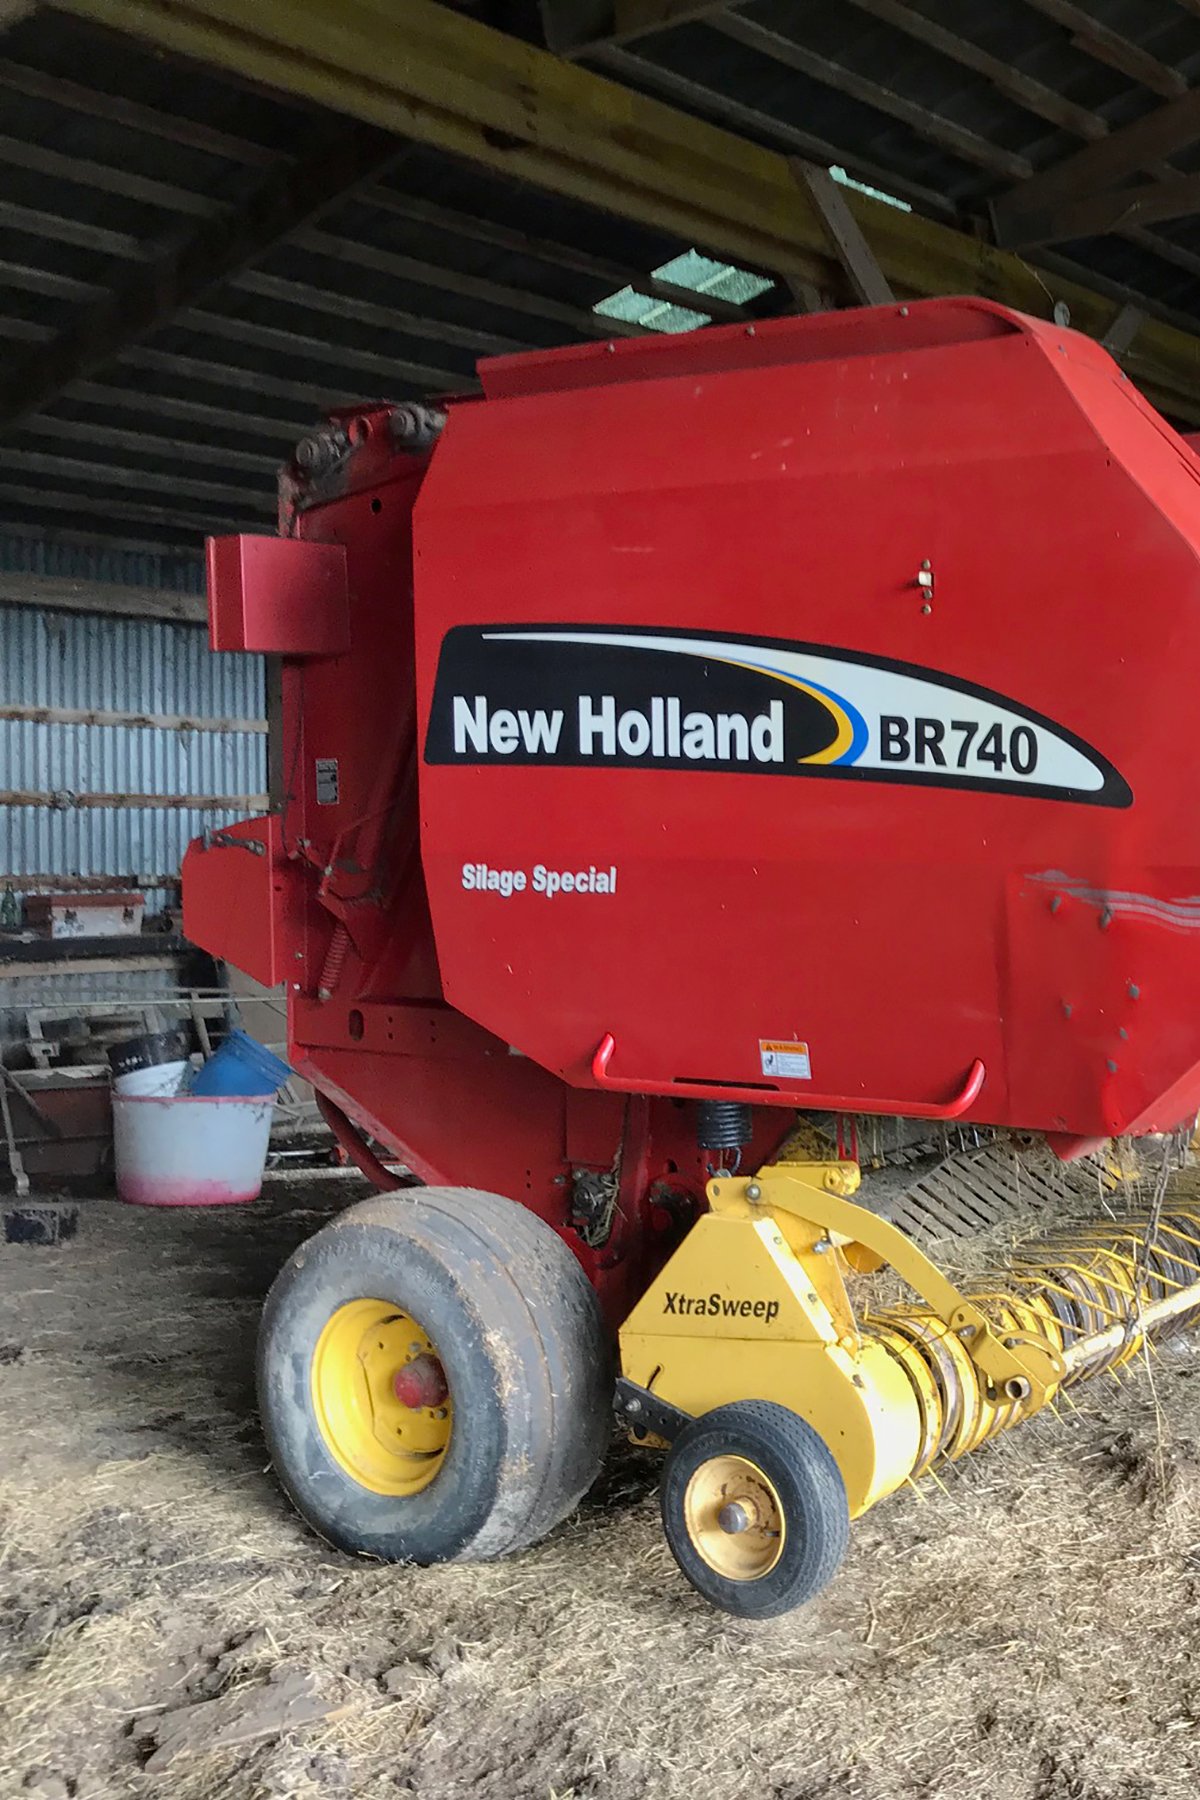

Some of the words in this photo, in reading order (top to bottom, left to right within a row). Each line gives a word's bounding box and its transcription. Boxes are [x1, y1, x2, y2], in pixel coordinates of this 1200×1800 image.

[453, 695, 564, 754] New
[578, 695, 784, 763] Holland
[880, 715, 1038, 775] BR740
[462, 863, 527, 897] Silage
[532, 864, 617, 898] Special
[663, 1292, 779, 1323] XtraSweep
